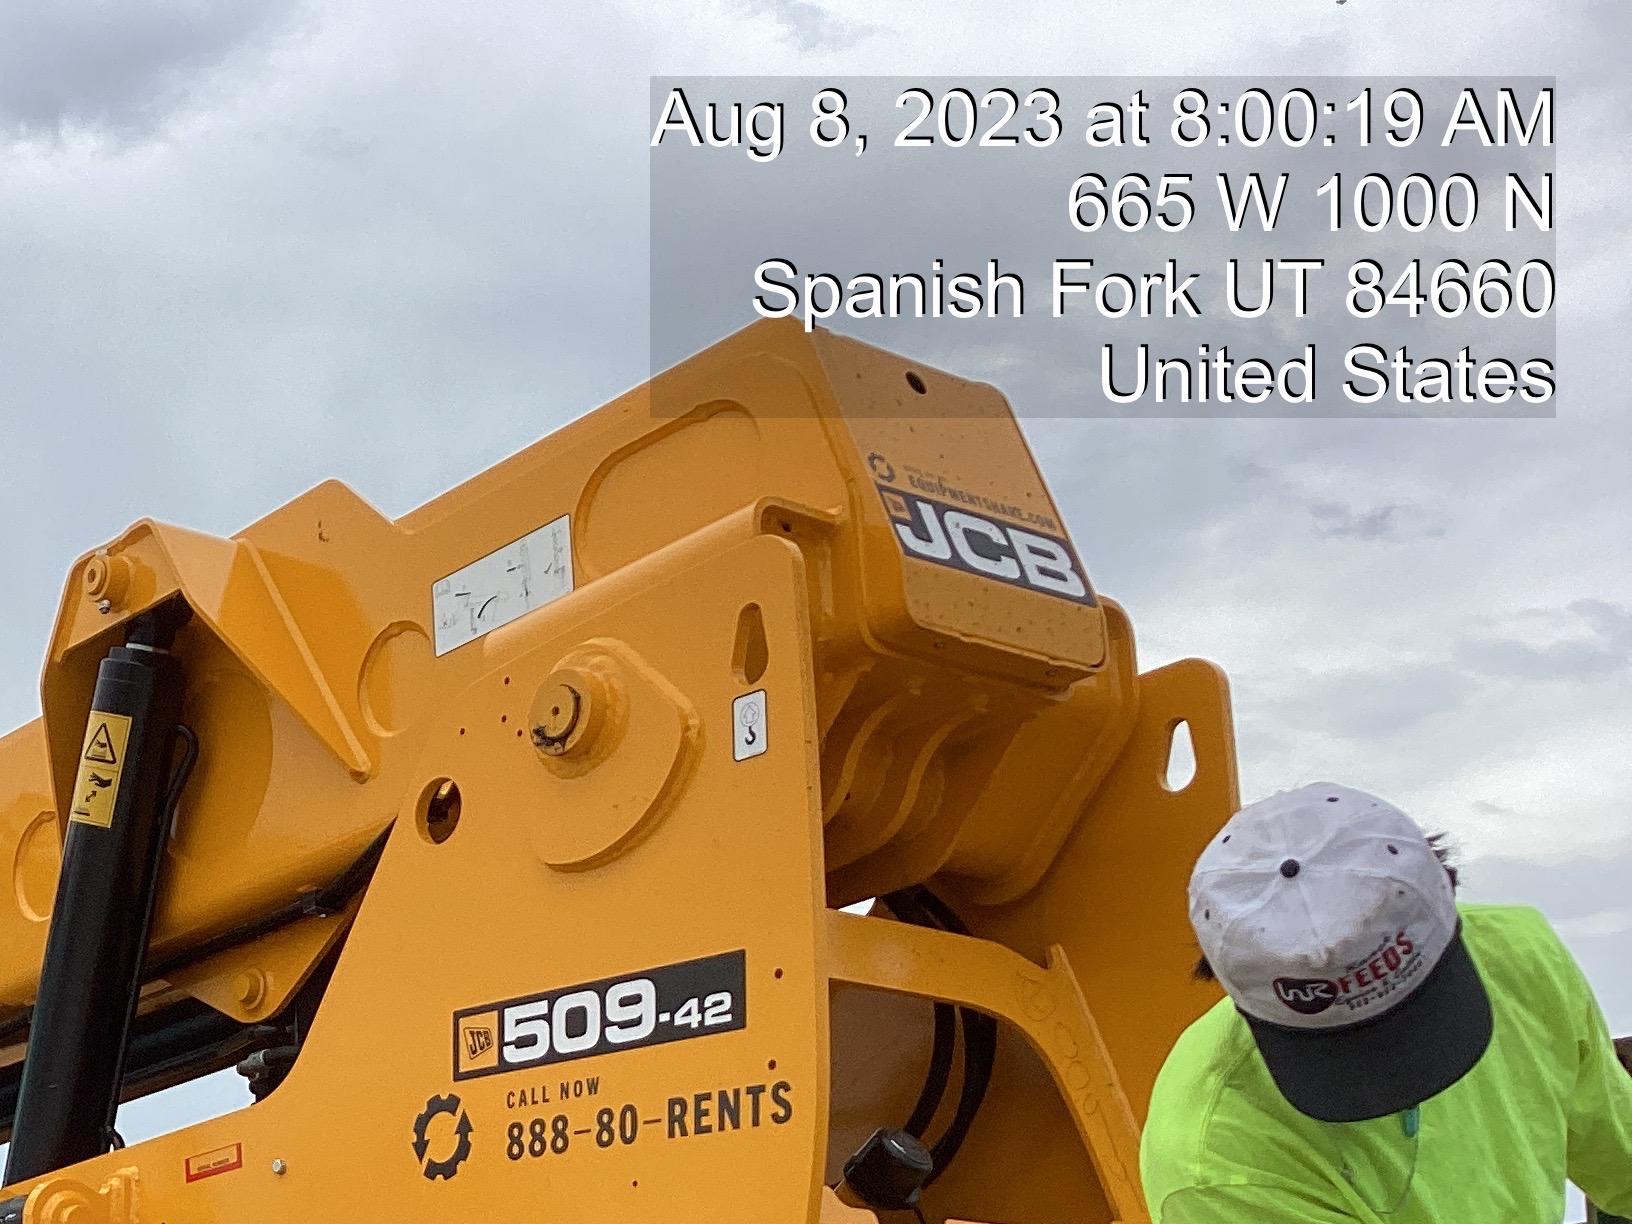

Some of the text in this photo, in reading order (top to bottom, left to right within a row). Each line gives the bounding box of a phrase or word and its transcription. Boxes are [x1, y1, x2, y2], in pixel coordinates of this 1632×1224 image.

[894, 499, 1088, 598] JCB
[1337, 927, 1414, 994] FEEDS
[468, 1030, 491, 1056] JCB
[502, 977, 733, 1064] 509-42
[505, 1079, 794, 1162] 888-80-RENTS
[506, 1076, 600, 1109] CALL NOW
